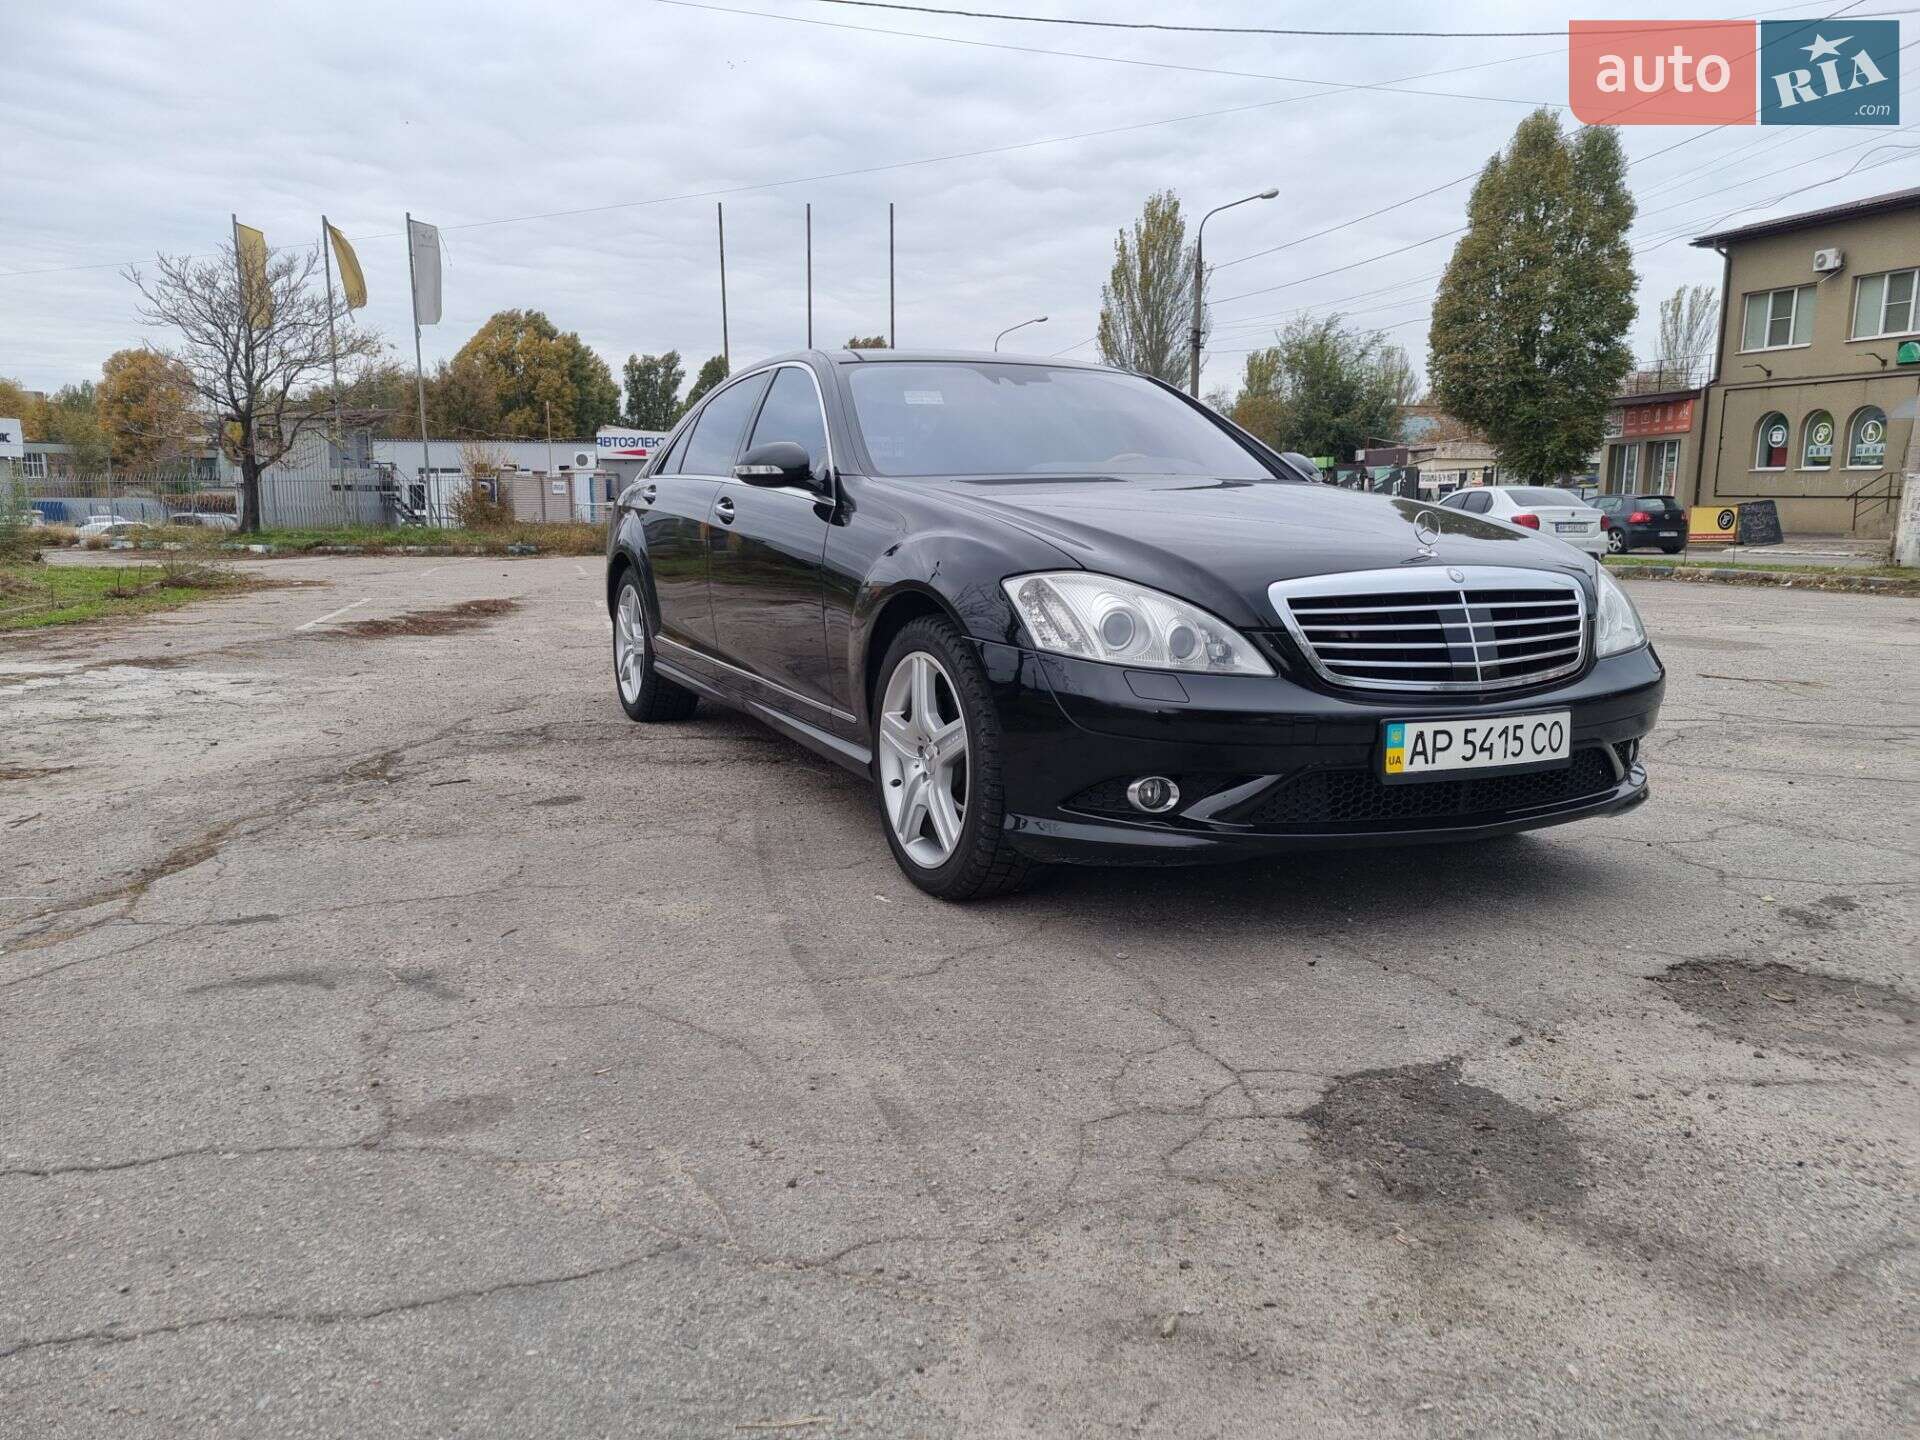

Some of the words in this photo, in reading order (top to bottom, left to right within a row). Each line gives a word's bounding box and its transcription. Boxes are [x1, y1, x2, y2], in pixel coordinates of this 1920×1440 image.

[596, 436, 666, 448] АВТОЭЛЕК
[1408, 729, 1453, 766] AP
[1388, 757, 1402, 766] UA
